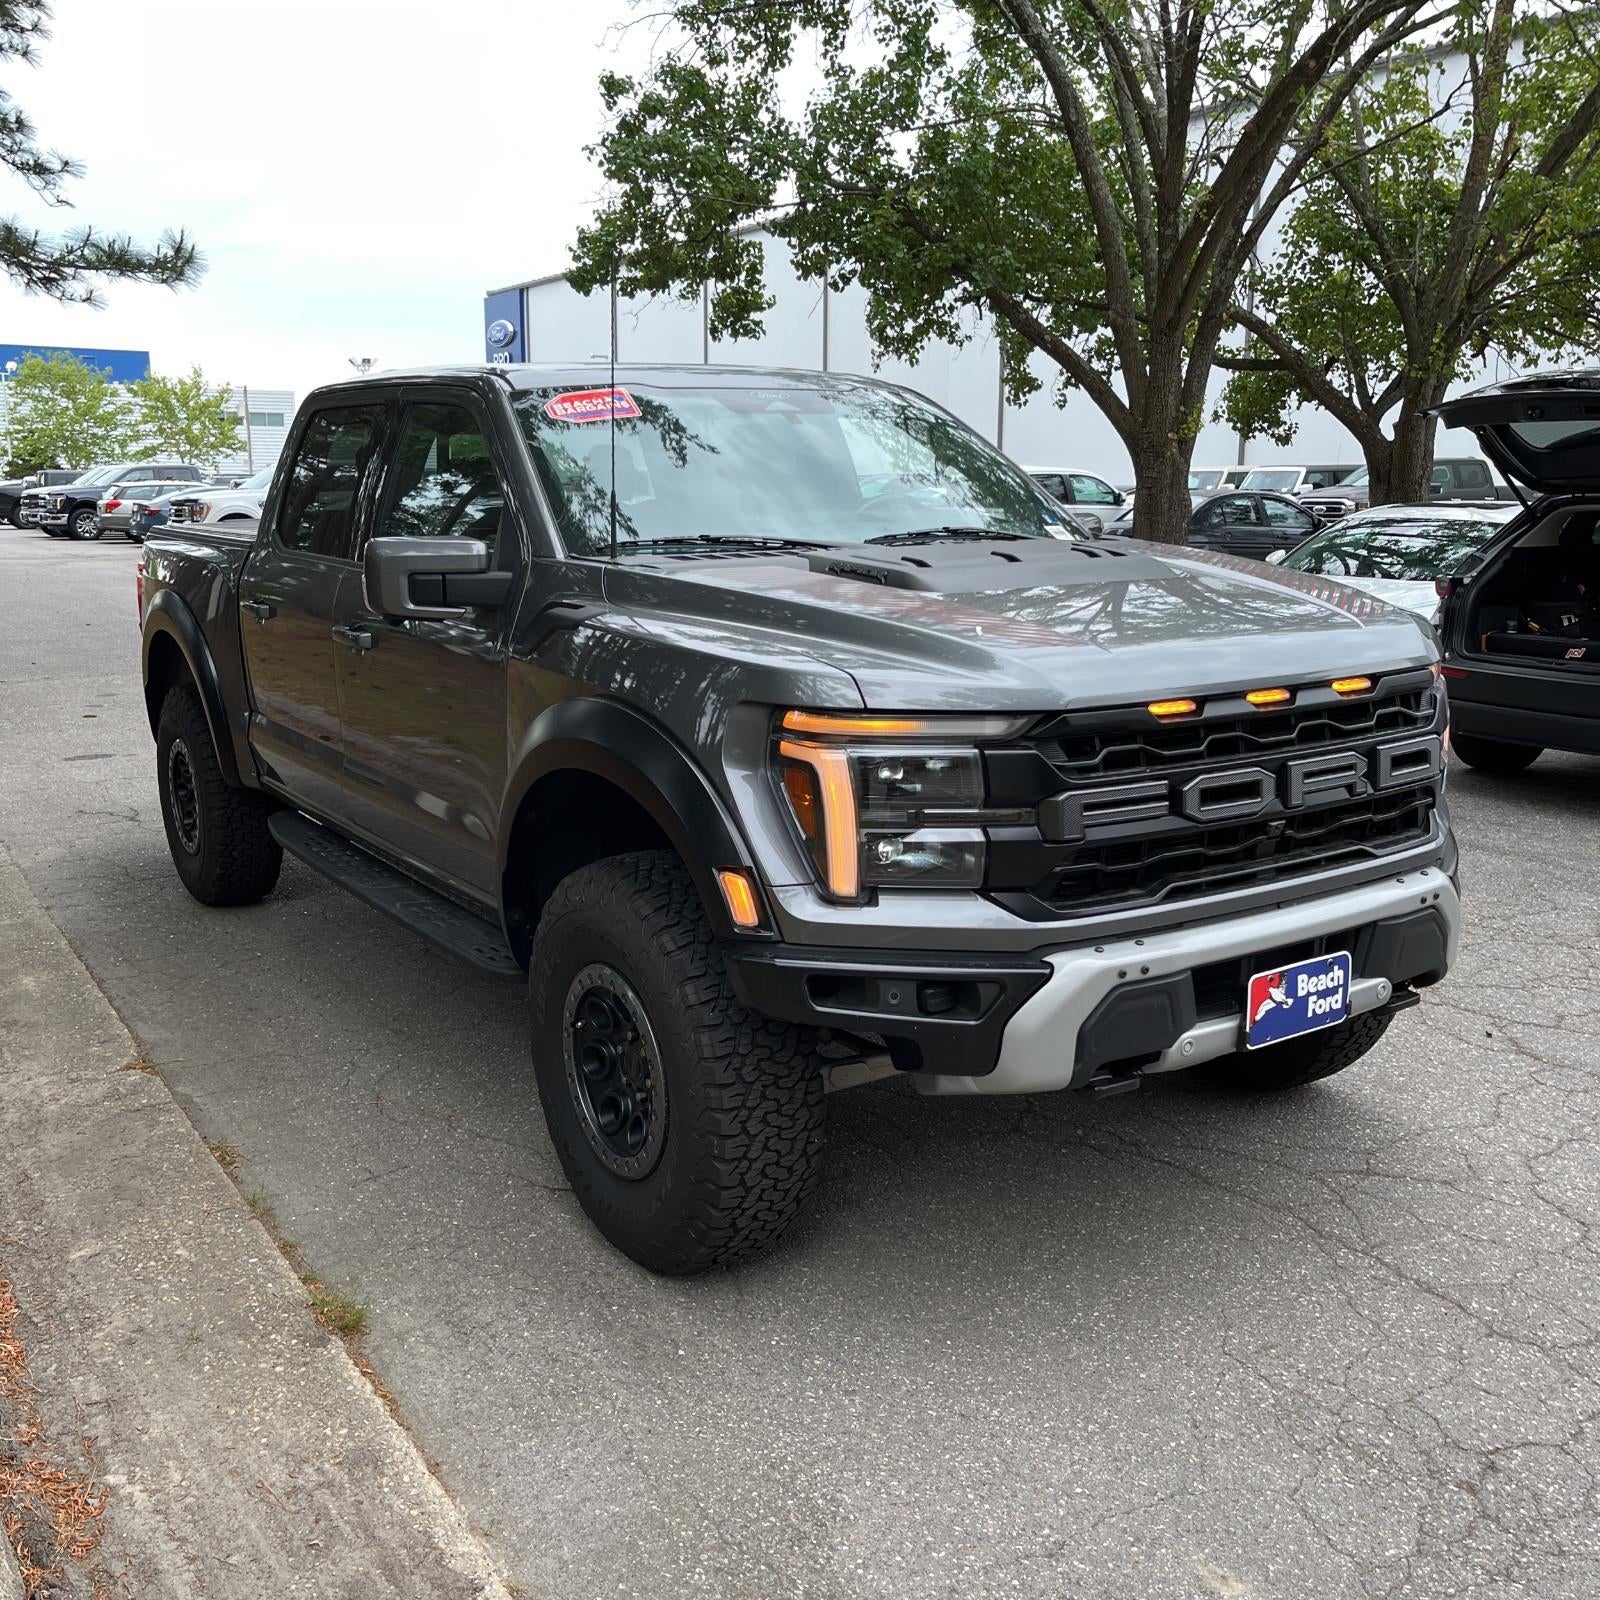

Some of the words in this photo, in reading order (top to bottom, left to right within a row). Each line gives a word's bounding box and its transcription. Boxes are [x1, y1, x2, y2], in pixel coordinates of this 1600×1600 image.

[556, 401, 630, 416] BARGAINS
[1042, 734, 1441, 842] FORD
[1297, 965, 1344, 997] Beach
[1307, 987, 1343, 1018] Ford
